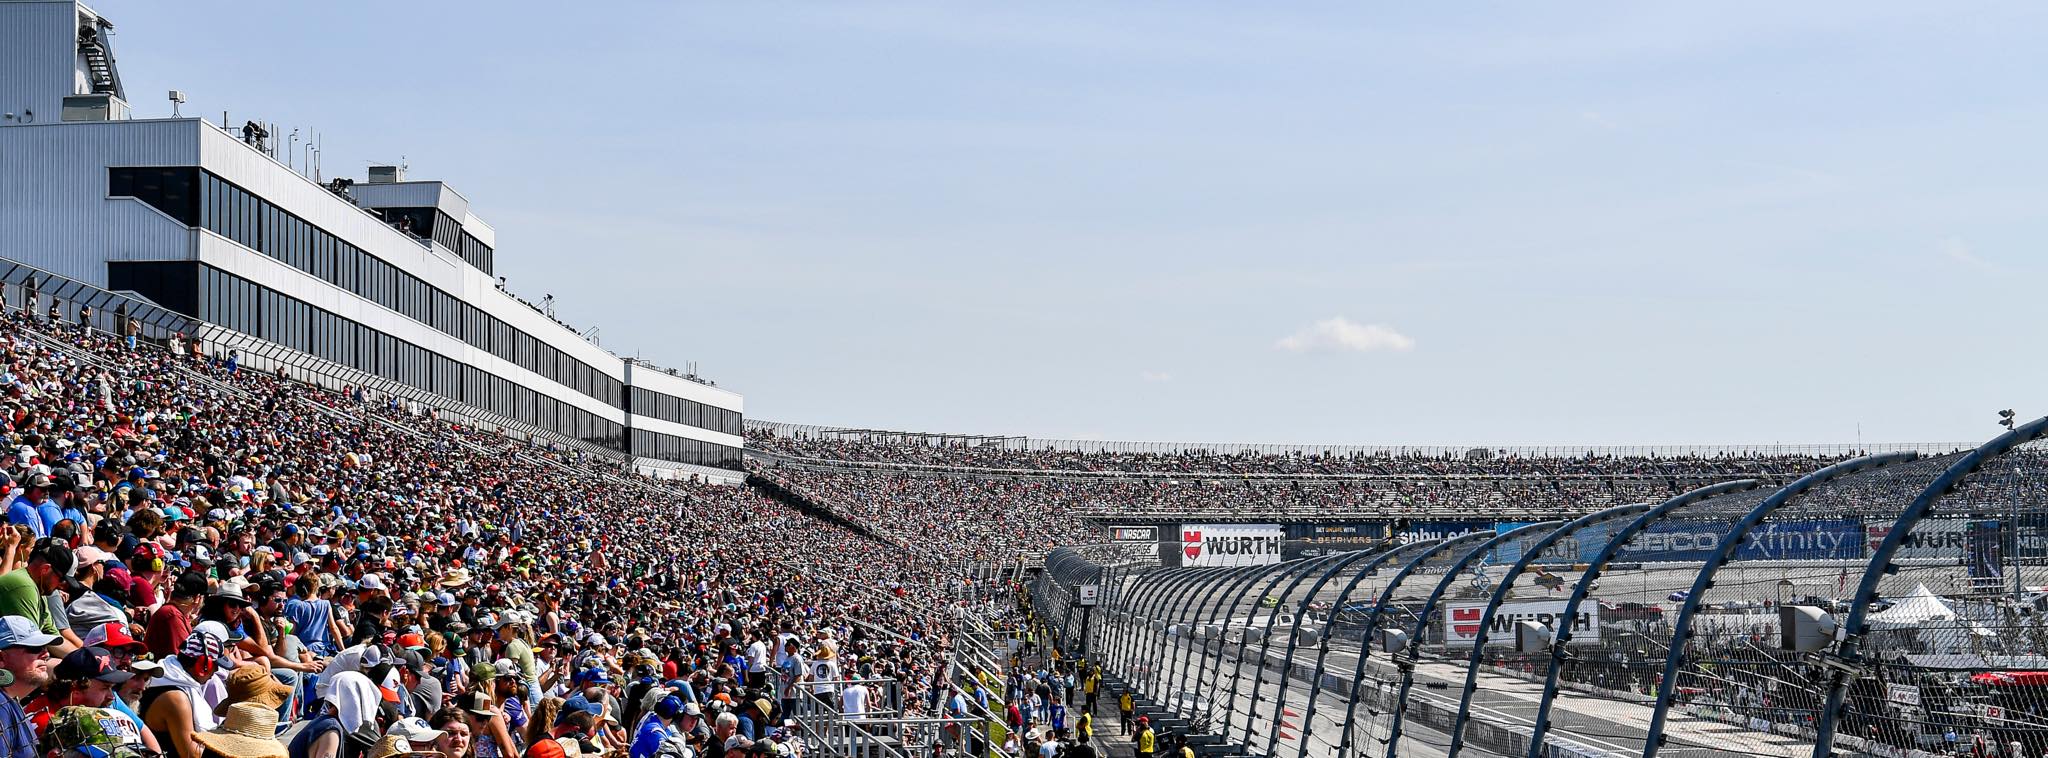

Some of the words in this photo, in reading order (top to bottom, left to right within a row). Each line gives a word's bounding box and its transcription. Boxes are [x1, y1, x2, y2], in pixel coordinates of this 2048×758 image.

[1123, 529, 1151, 540] NASCAR
[1317, 536, 1372, 544] BETRIVERS
[1400, 528, 1475, 545] snhu.ed
[1749, 523, 1845, 558] xfinity
[1520, 539, 1580, 561] BSCH
[1489, 612, 1591, 633] WRH
